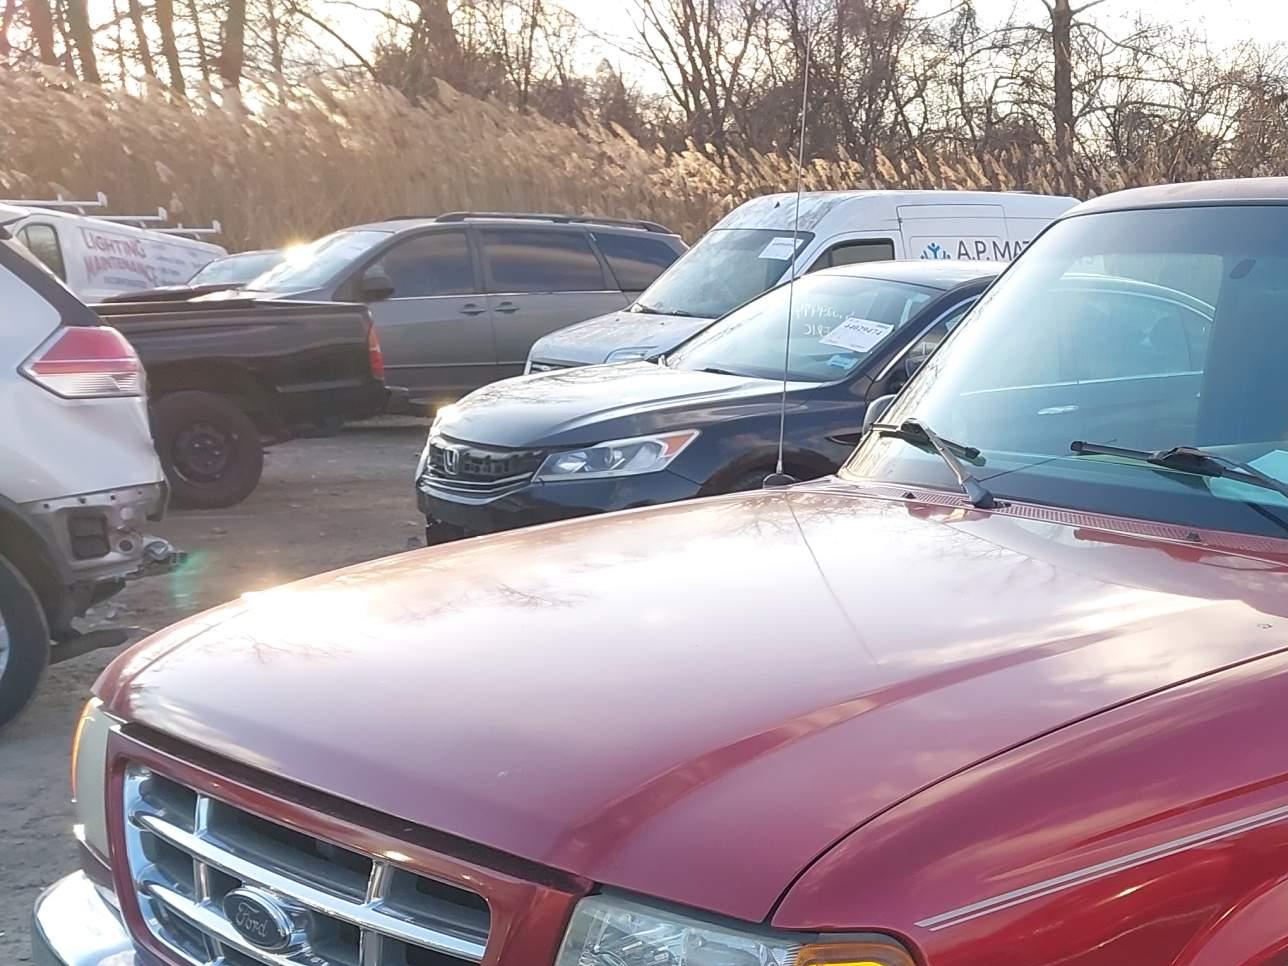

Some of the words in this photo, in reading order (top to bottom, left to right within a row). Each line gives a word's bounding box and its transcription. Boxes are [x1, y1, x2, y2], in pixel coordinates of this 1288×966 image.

[81, 227, 147, 259] LIGHTING
[957, 240, 990, 261] A.P.
[235, 902, 268, 937] Ford
